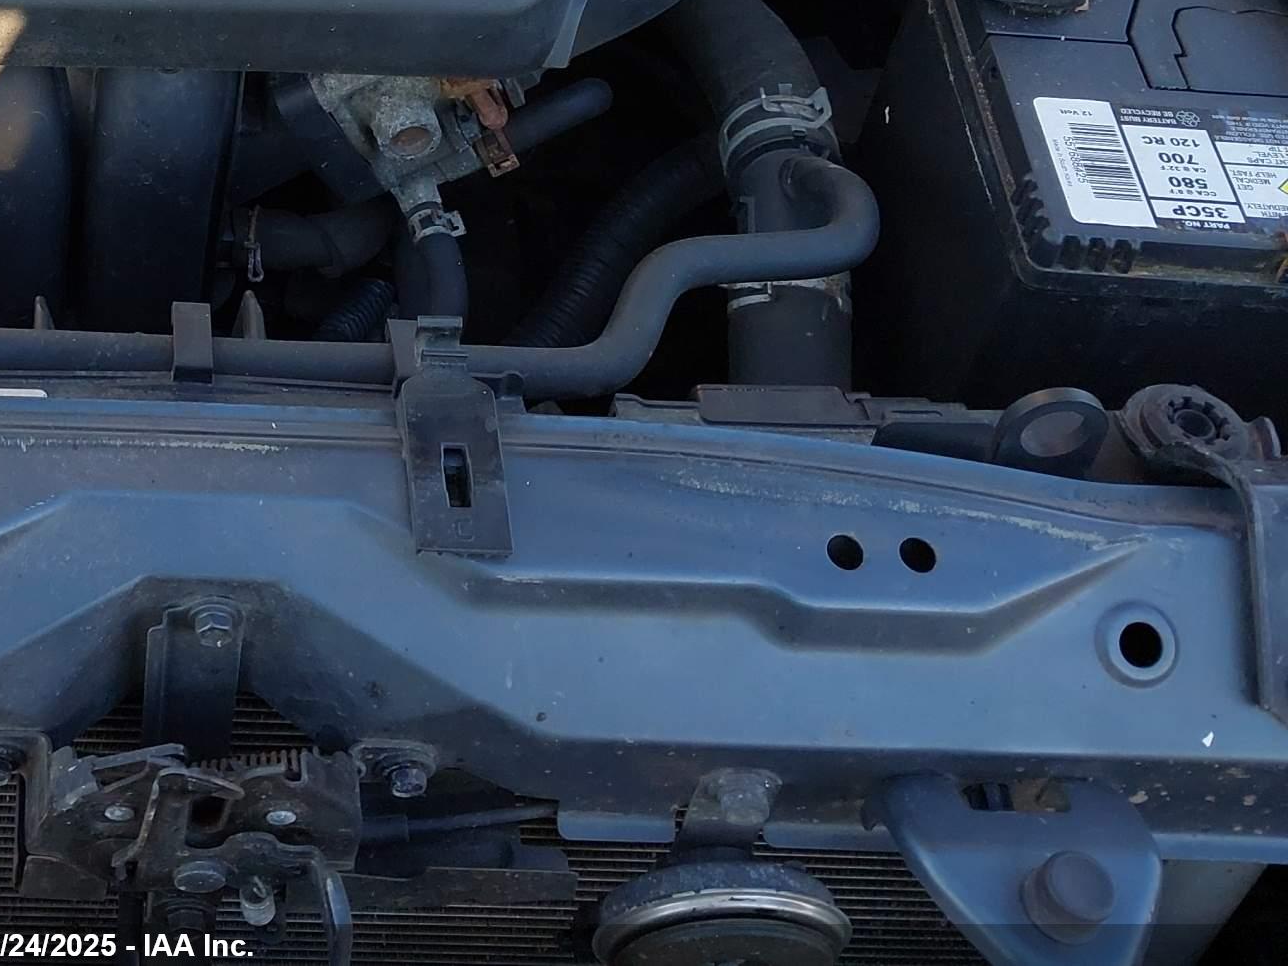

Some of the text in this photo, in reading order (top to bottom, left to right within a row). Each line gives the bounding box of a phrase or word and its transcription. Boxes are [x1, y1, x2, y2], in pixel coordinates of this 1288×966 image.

[1140, 135, 1200, 148] 120 RC
[1158, 152, 1198, 165] 700
[1169, 177, 1208, 189] 580
[1172, 205, 1228, 219] 35CP
